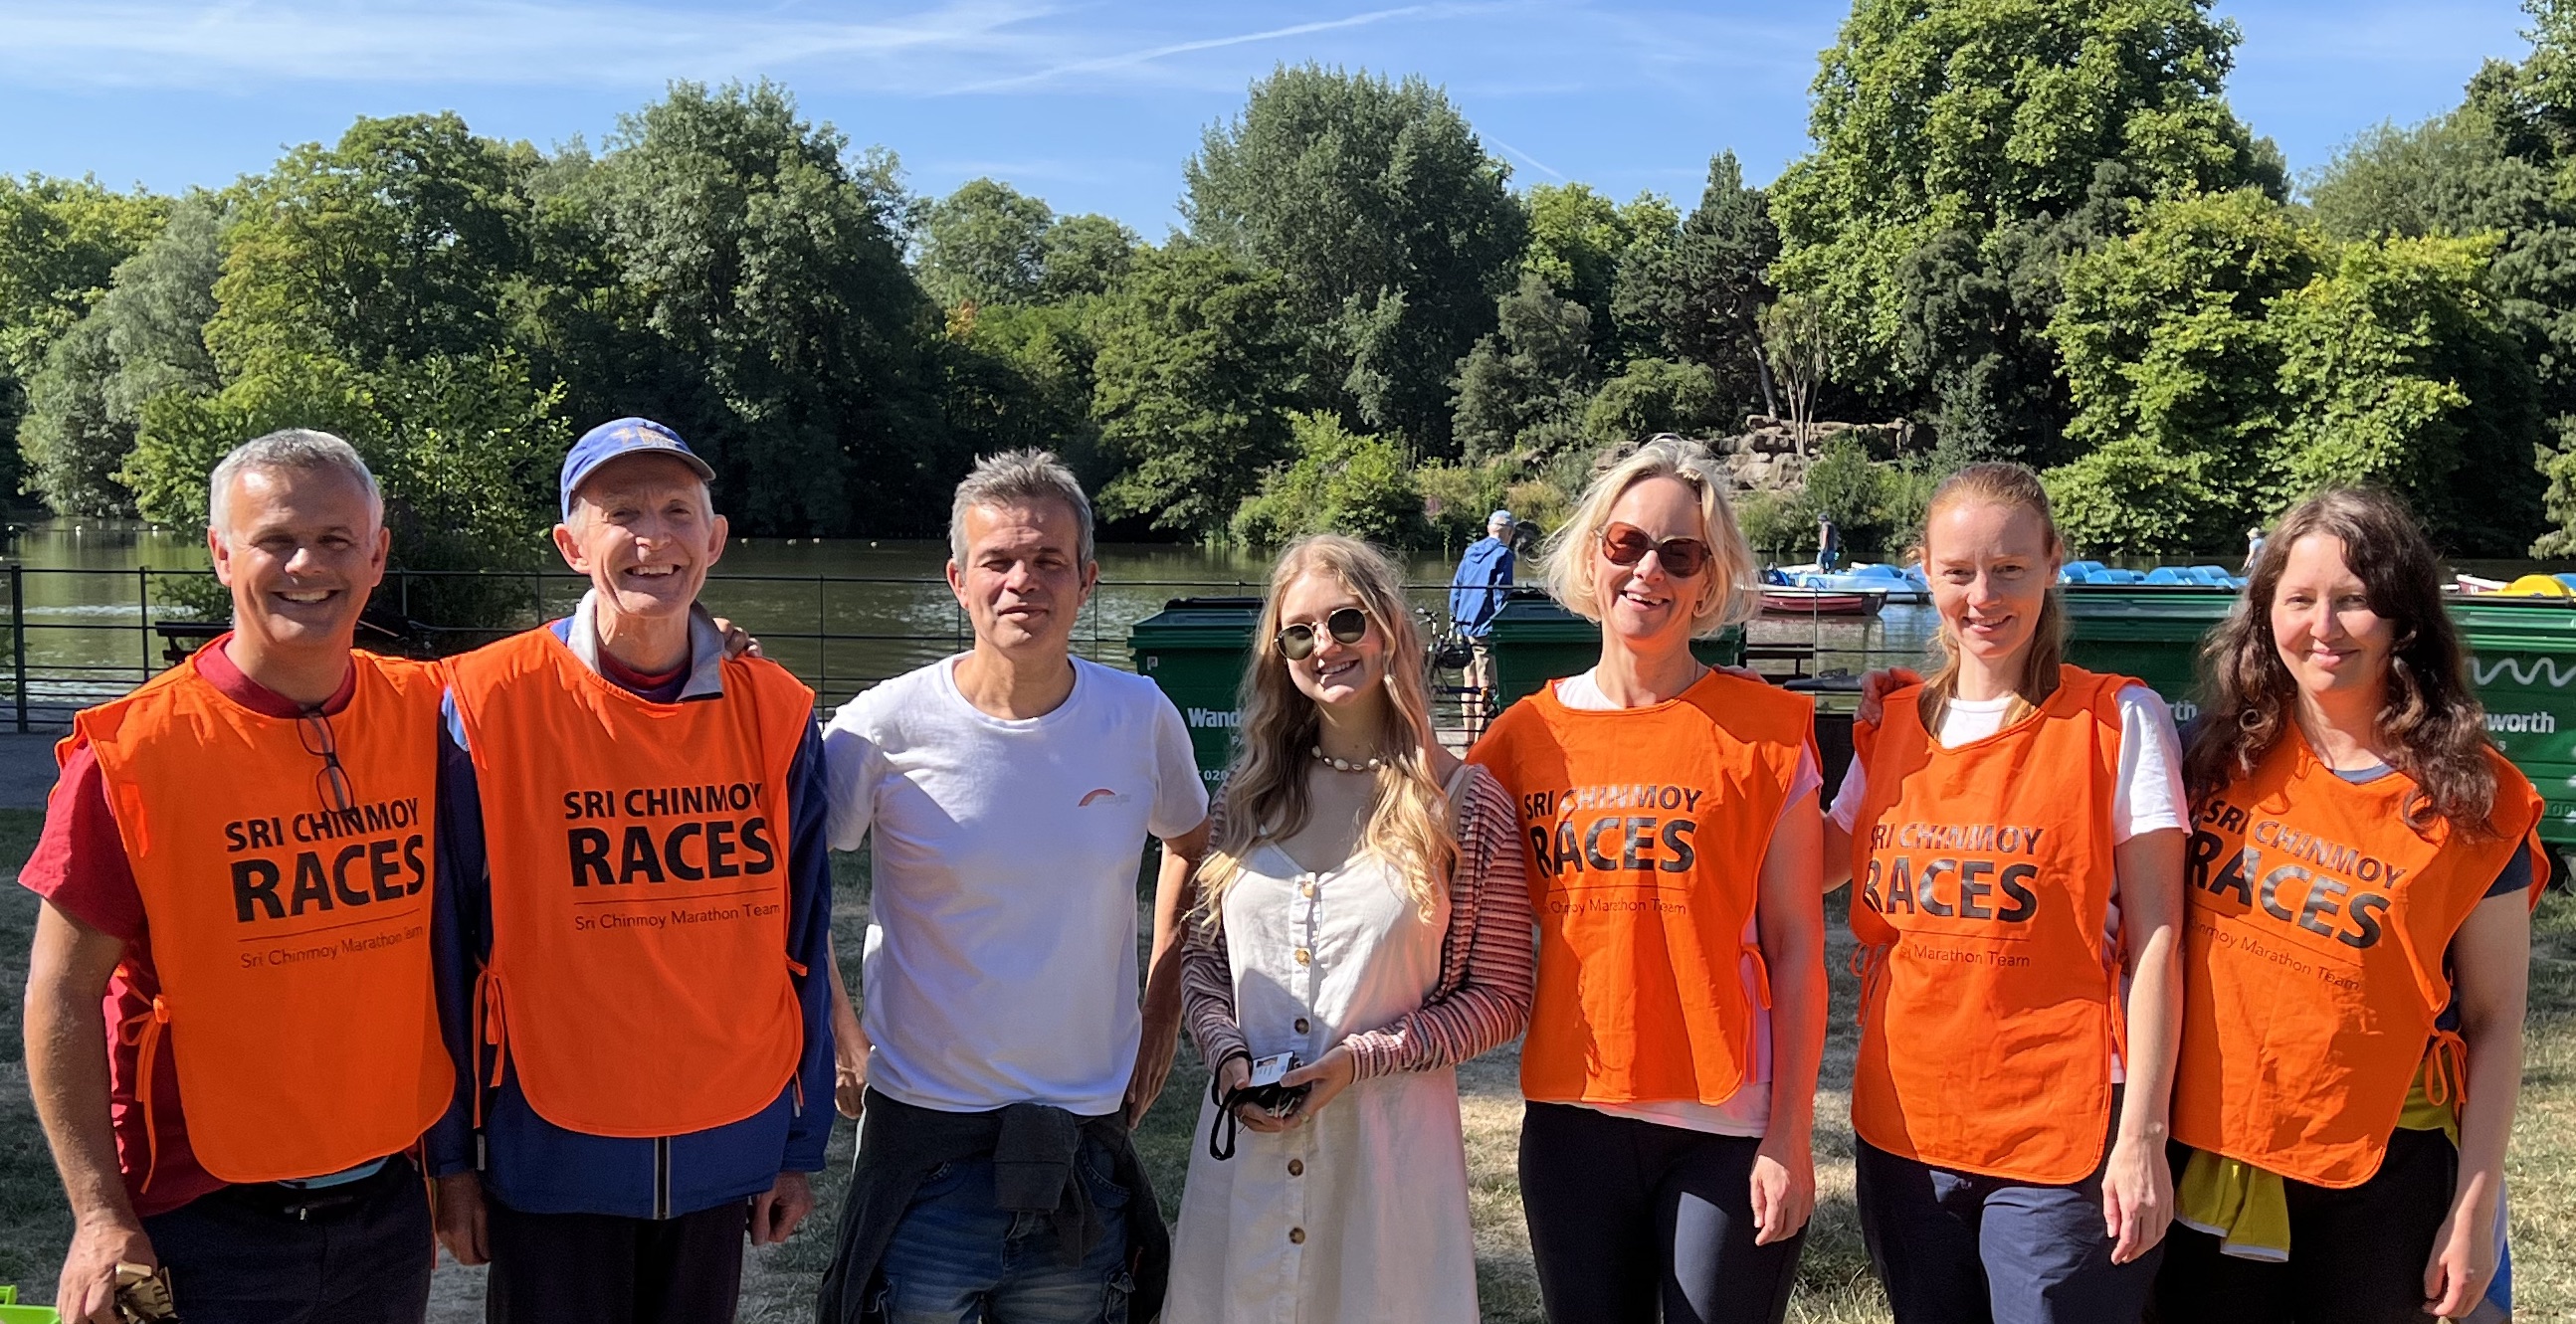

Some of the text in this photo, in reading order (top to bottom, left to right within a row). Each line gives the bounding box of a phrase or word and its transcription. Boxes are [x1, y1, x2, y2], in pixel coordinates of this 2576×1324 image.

[1187, 707, 1242, 728] Wand
[2486, 711, 2555, 734] worth
[563, 782, 763, 820] SRI CHINMOY
[1523, 785, 1702, 821] SRI CHINMOY
[225, 797, 418, 852] SRI CHINMOY
[1871, 823, 2045, 855] RI CHINMOY
[567, 817, 775, 887] RACES
[1529, 817, 1697, 879] RACES
[2255, 821, 2406, 889] CHINMOY
[230, 835, 426, 923] RACES
[1863, 856, 2039, 924] RACES
[2188, 830, 2392, 950] RACES
[574, 903, 781, 931] Sri Chinmoy Marathon Team
[240, 950, 264, 969] Sri
[268, 944, 338, 966] Chinmoy
[340, 931, 402, 954] Marathon
[1913, 943, 1984, 965] Marathon
[1987, 950, 2031, 968] Team
[2242, 936, 2311, 975] Marathon
[2317, 966, 2360, 991] Team
